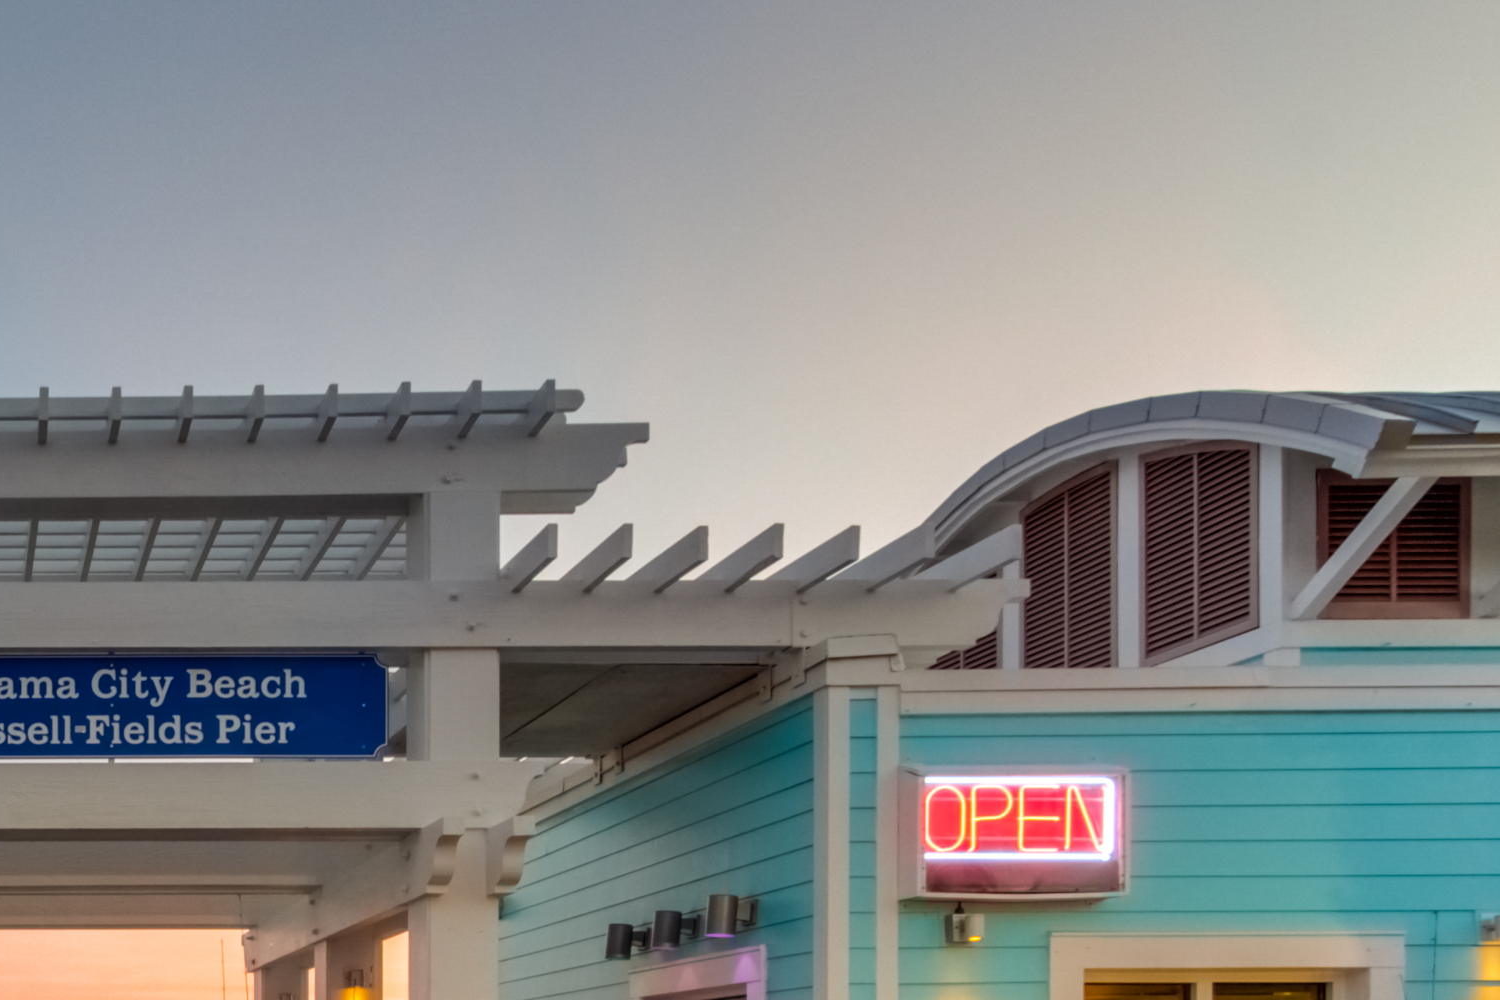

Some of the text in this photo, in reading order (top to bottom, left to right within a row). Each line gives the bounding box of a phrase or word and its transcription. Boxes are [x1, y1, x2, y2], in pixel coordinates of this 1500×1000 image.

[92, 668, 174, 707] City
[186, 668, 307, 699] Beach
[216, 715, 296, 745] Pier
[925, 785, 1106, 853] OPEN
